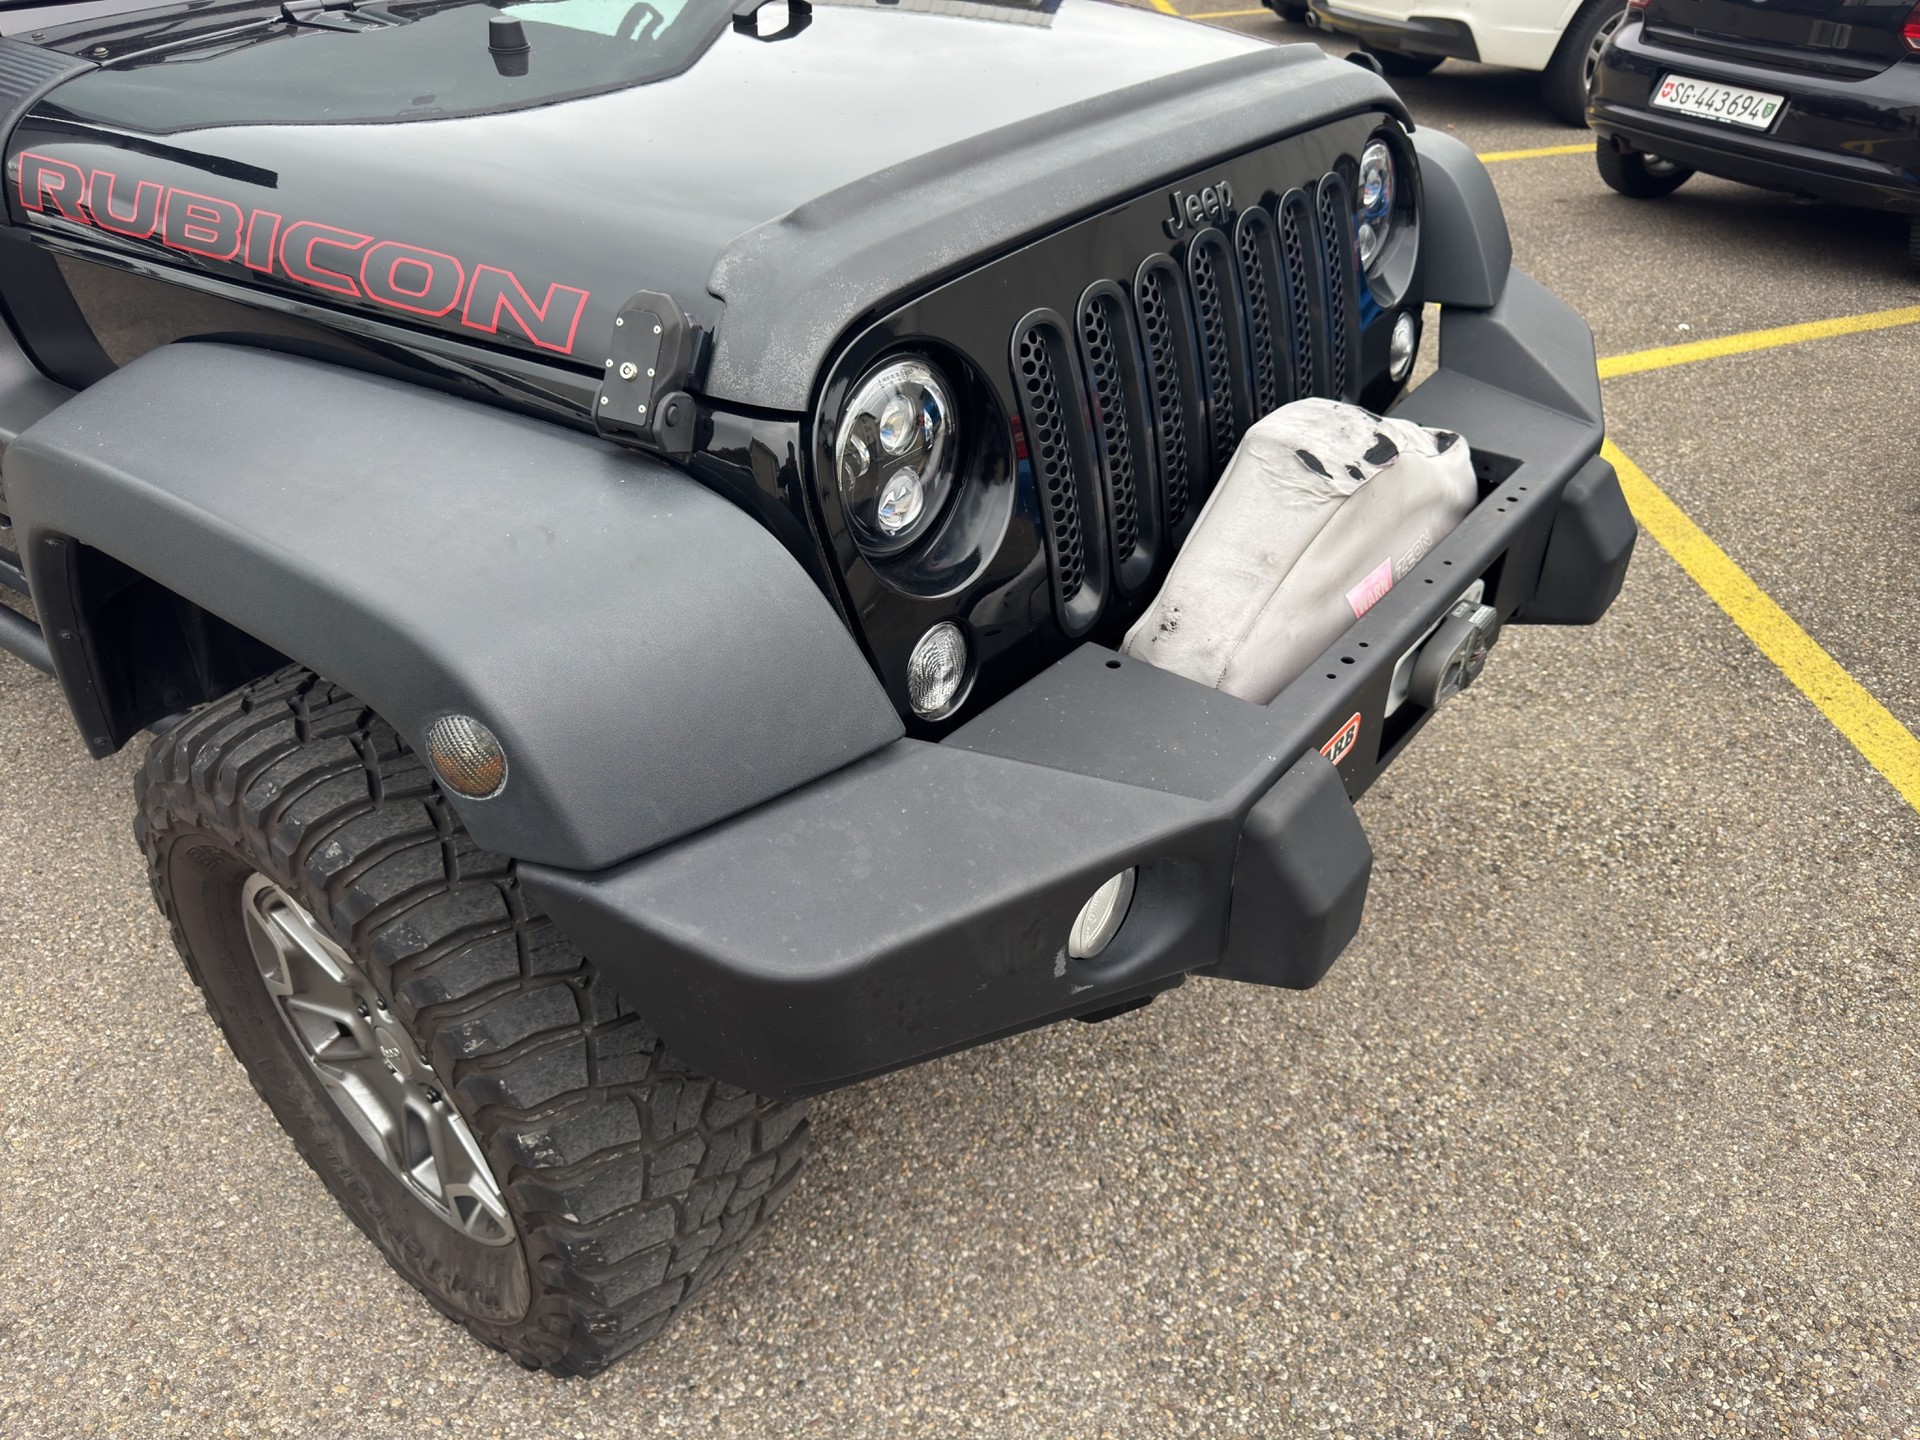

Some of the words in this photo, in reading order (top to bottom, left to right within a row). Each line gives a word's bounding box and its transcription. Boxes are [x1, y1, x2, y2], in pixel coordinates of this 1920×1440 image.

[1163, 180, 1234, 239] Jeep
[18, 151, 591, 354] RUBICON
[1395, 527, 1433, 580] ZEON
